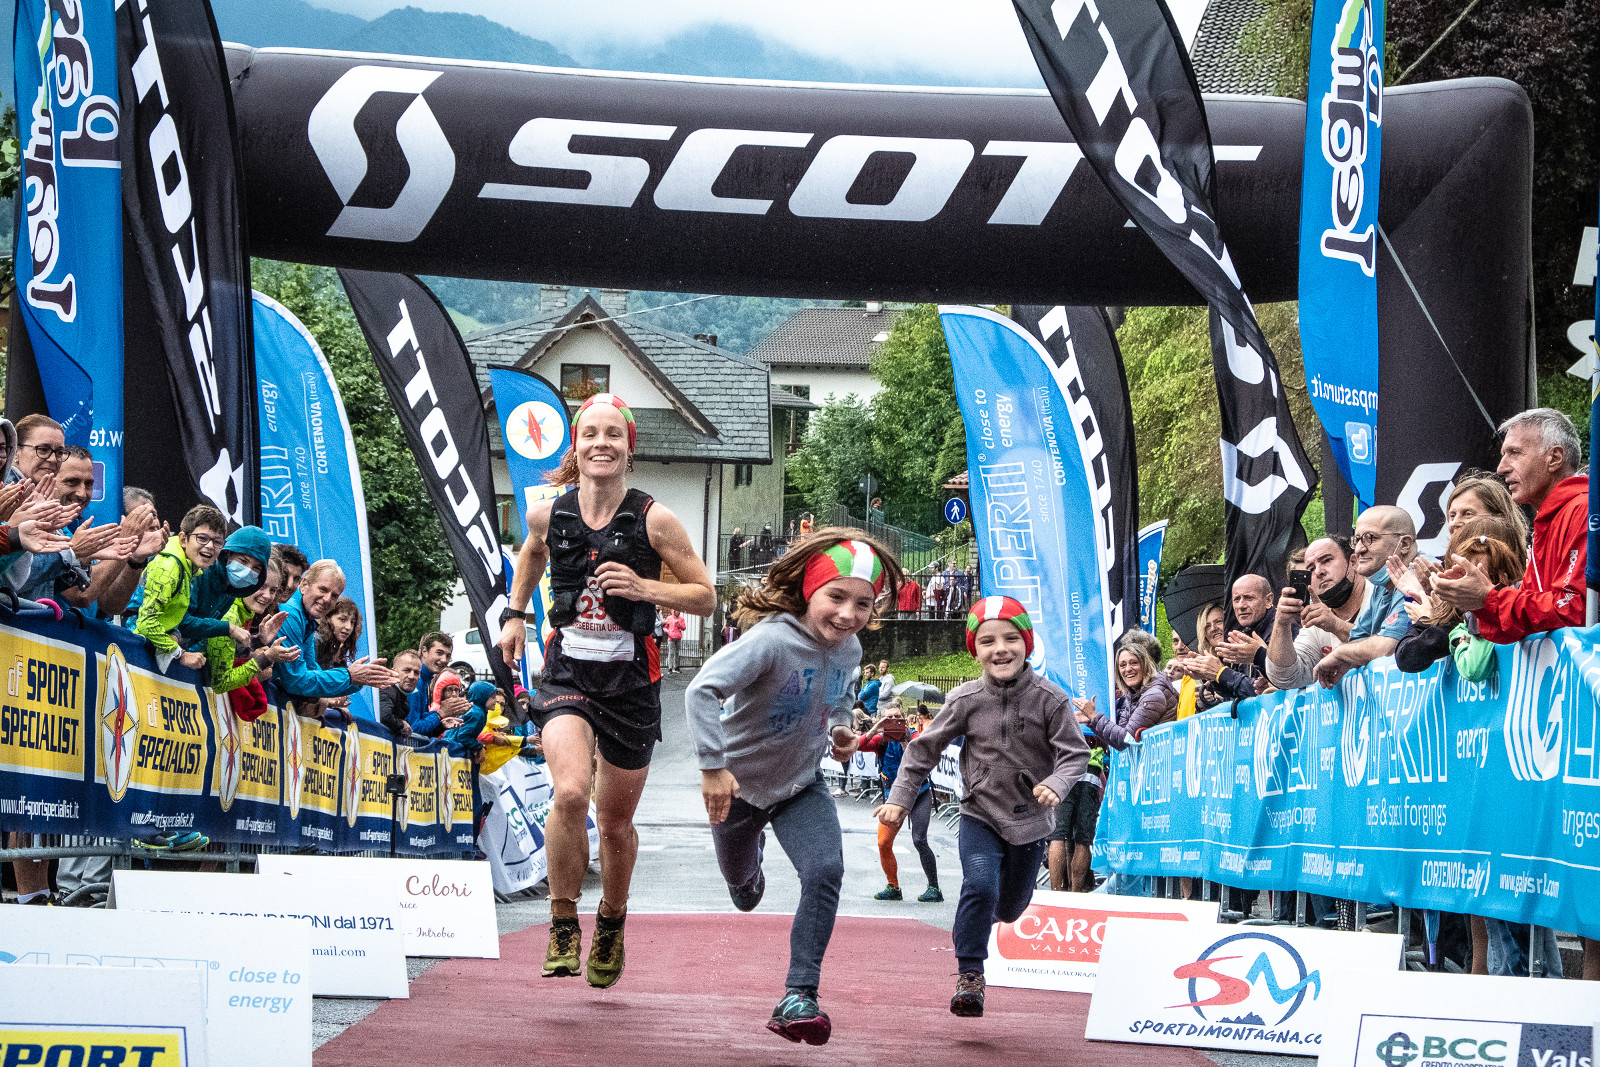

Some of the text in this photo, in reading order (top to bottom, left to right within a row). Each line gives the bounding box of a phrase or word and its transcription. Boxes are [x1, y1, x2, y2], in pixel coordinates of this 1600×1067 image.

[261, 379, 278, 433] energy
[304, 370, 329, 475] CORTENOVA (Italy)
[975, 388, 995, 450] close to
[995, 393, 1014, 448] energy
[1037, 385, 1067, 486] CORTENOVA (Italy)
[294, 446, 311, 510] since 1740
[1031, 459, 1050, 523] since 1740
[26, 658, 80, 710] SPORT
[1, 704, 79, 756] SPECIALIST
[160, 695, 201, 737] SPORT
[137, 734, 202, 775] SPECIALIST
[251, 719, 277, 753] SPORT
[313, 735, 340, 770] SPORT
[241, 751, 278, 787] SPECIALIST
[304, 766, 337, 800] SPECIALIST
[405, 873, 473, 898] Colori
[333, 915, 356, 930] dal
[359, 916, 394, 931] 1971
[416, 926, 456, 939] Introbio
[312, 946, 366, 957] mail.com
[228, 967, 301, 985] close to
[228, 995, 293, 1014] energy
[1422, 1035, 1508, 1062] BCC
